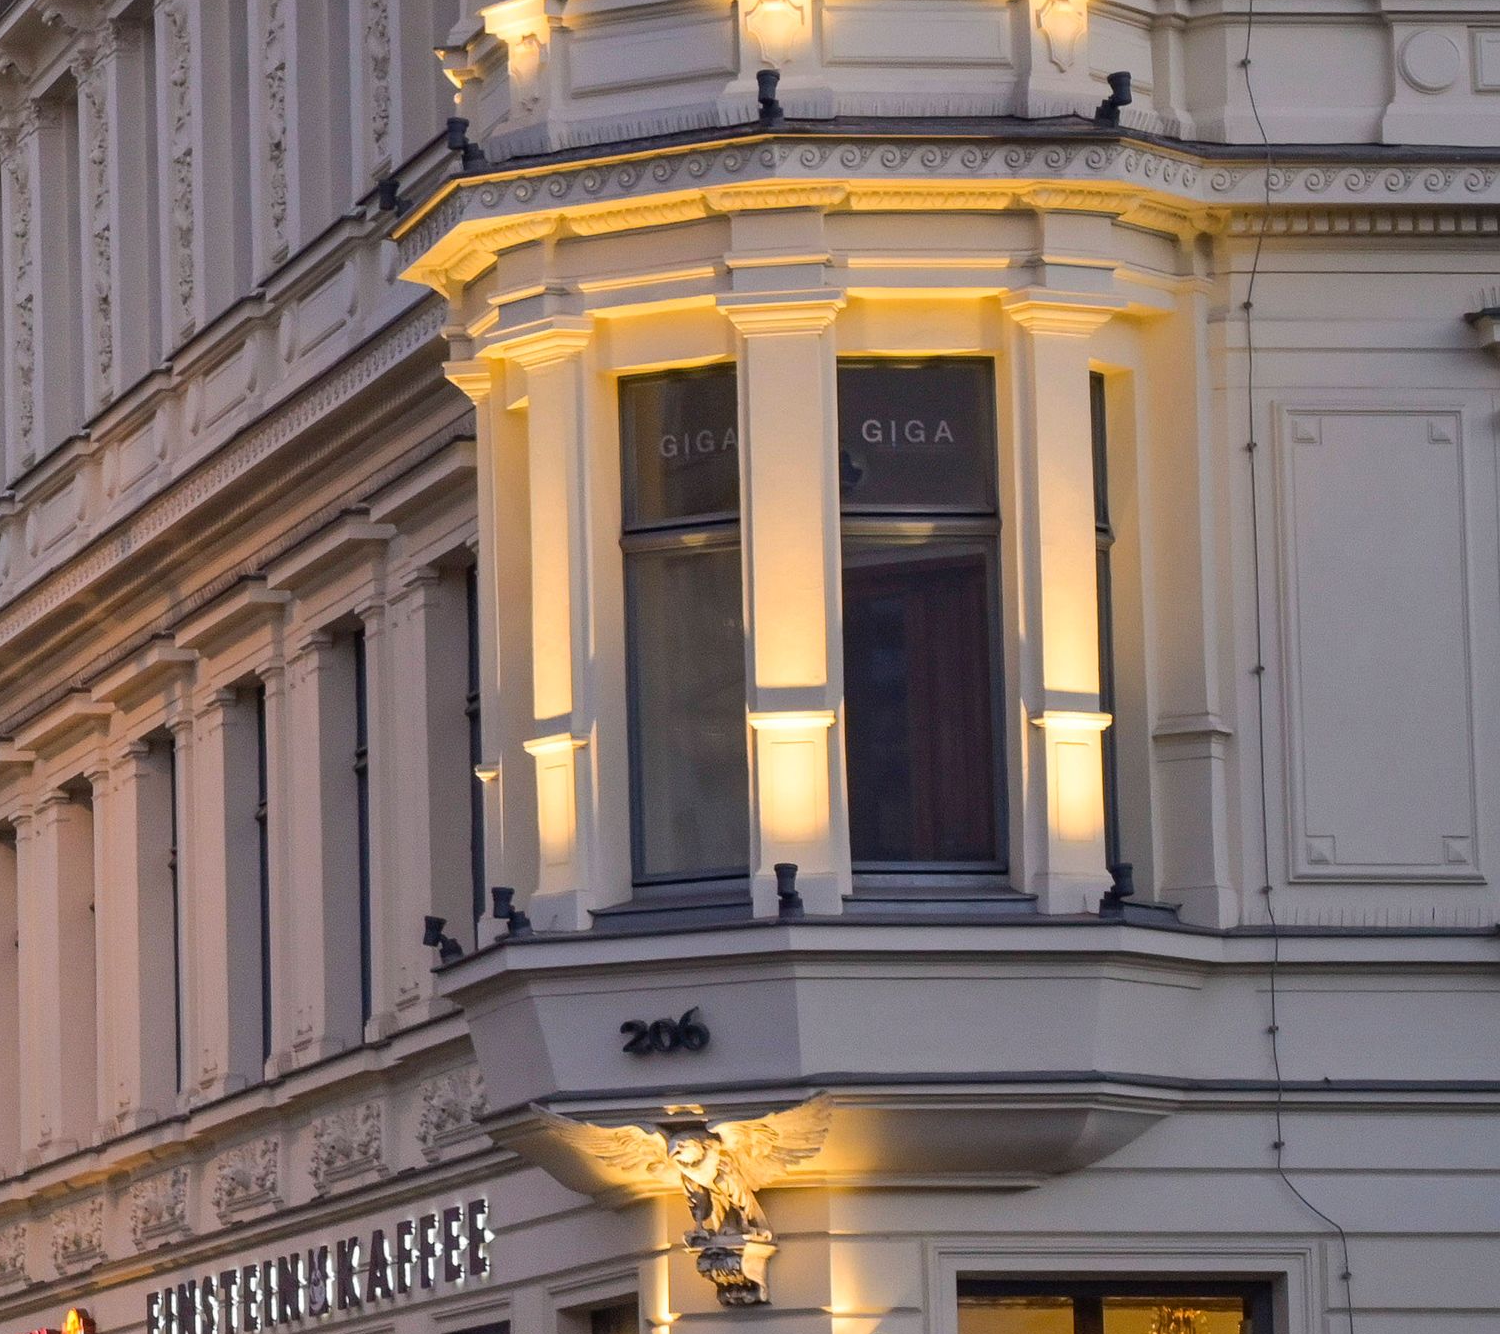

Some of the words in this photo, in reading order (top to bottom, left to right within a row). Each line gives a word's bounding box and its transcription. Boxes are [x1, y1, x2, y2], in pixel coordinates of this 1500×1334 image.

[659, 427, 737, 464] GIGA
[860, 419, 955, 447] GIGA
[619, 1006, 711, 1056] 206
[336, 1197, 495, 1310] KAFFEE
